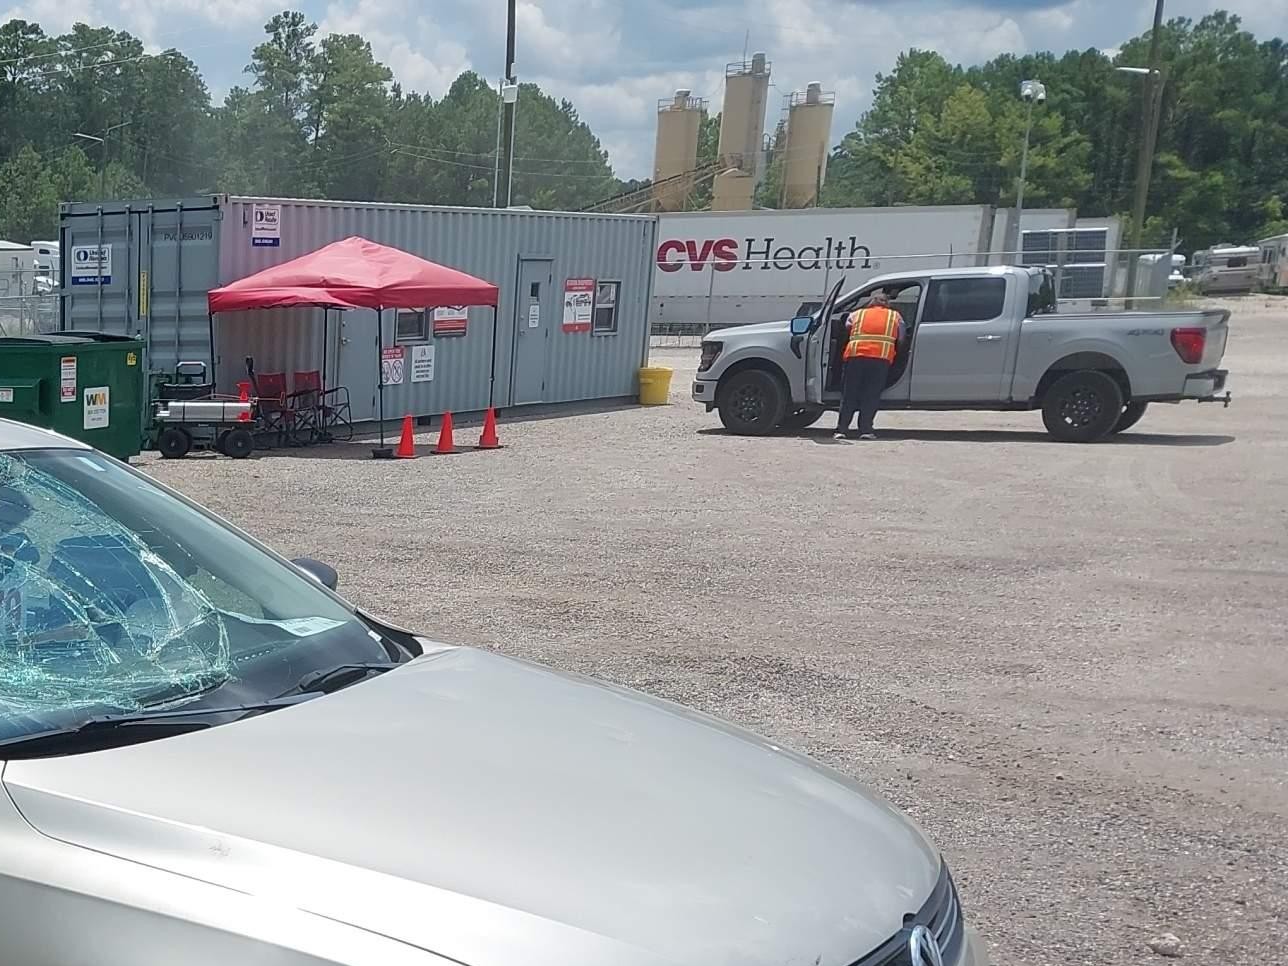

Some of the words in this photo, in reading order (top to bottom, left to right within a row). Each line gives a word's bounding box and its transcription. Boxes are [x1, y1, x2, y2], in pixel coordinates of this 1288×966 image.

[656, 238, 738, 272] CVS
[742, 236, 872, 271] Health
[86, 392, 106, 406] WM
